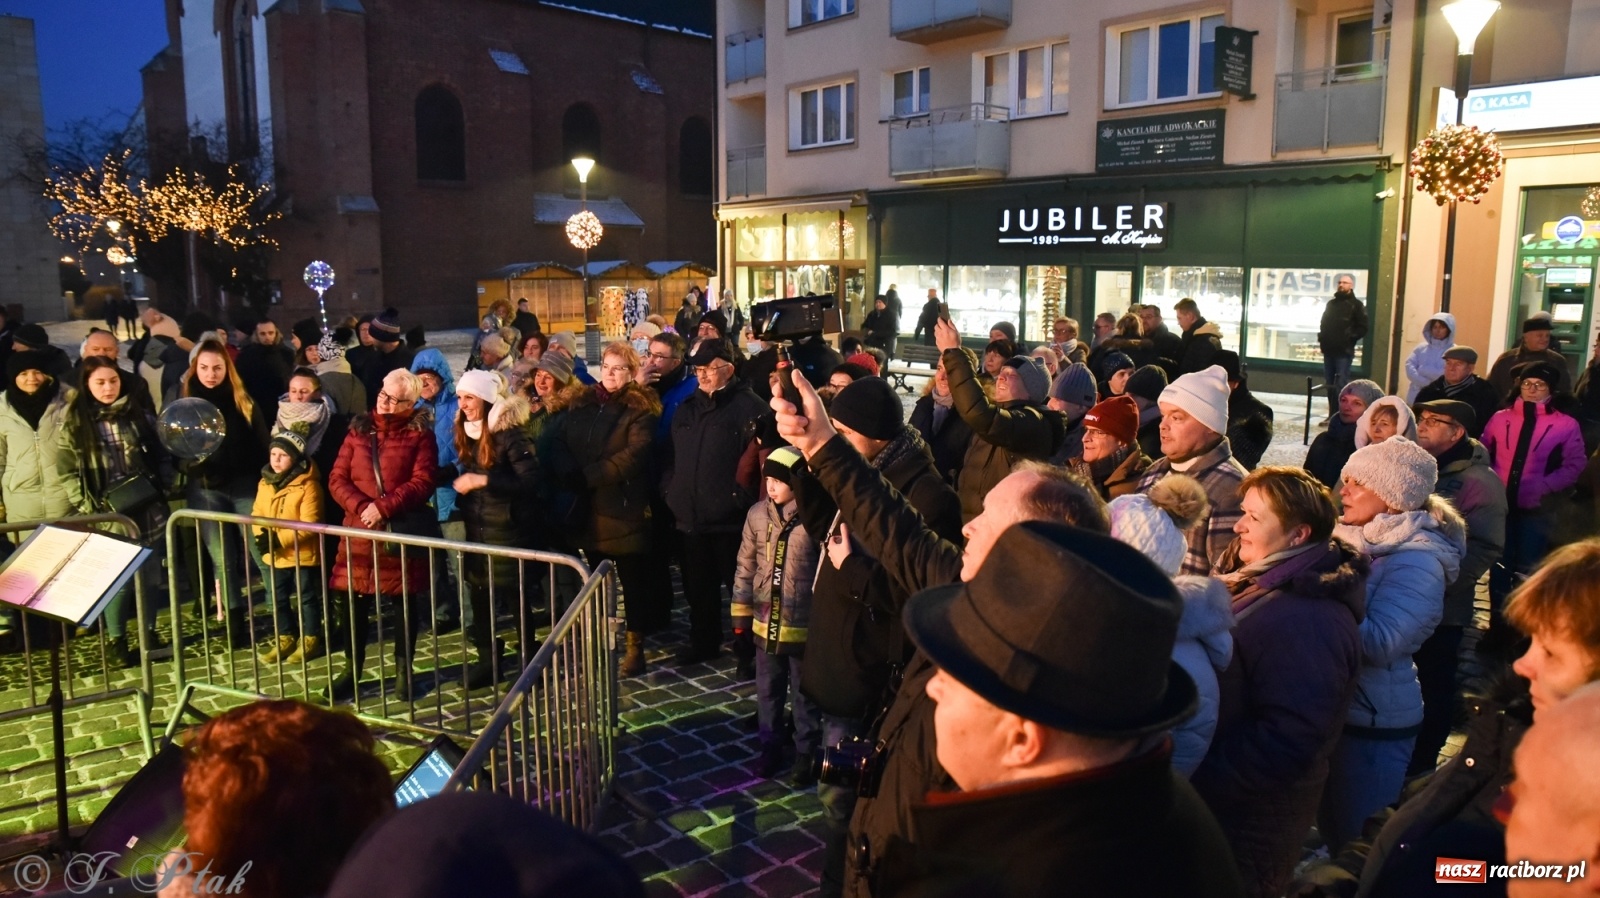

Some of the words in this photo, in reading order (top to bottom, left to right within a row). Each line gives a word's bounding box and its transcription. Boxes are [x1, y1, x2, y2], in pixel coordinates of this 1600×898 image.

[1488, 94, 1529, 109] KASA
[1117, 125, 1162, 136] KANCELARIE
[1164, 120, 1217, 132] ADWOKACKIE
[999, 204, 1164, 232] JUBILER
[1032, 235, 1059, 245] 1989
[775, 540, 786, 565] GAMES
[773, 566, 782, 586] PLAY
[771, 596, 780, 619] GAMES
[769, 621, 778, 640] PLAY
